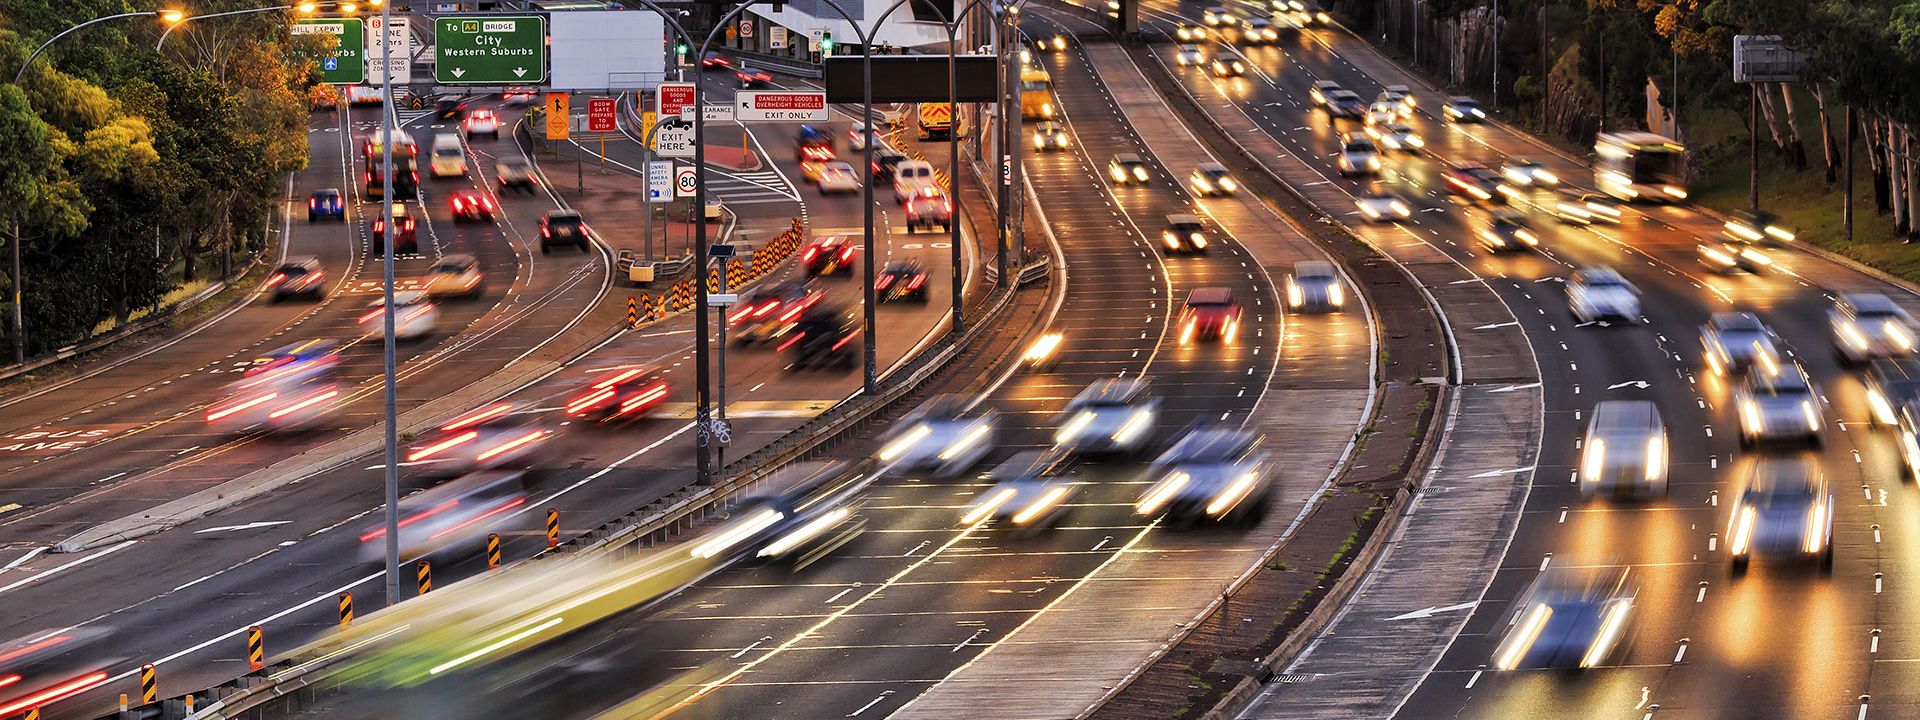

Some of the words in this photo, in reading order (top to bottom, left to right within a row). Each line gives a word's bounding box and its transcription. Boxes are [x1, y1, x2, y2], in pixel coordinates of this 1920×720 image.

[446, 23, 458, 32] To
[464, 23, 477, 31] A4
[475, 35, 502, 47] City
[444, 48, 486, 57] Western
[491, 47, 534, 56] Suburbs
[661, 133, 683, 141] EXIT
[660, 142, 685, 150] HERE
[681, 176, 696, 187] 80
[13, 430, 110, 439] BUS
[0, 441, 88, 450] ANE
